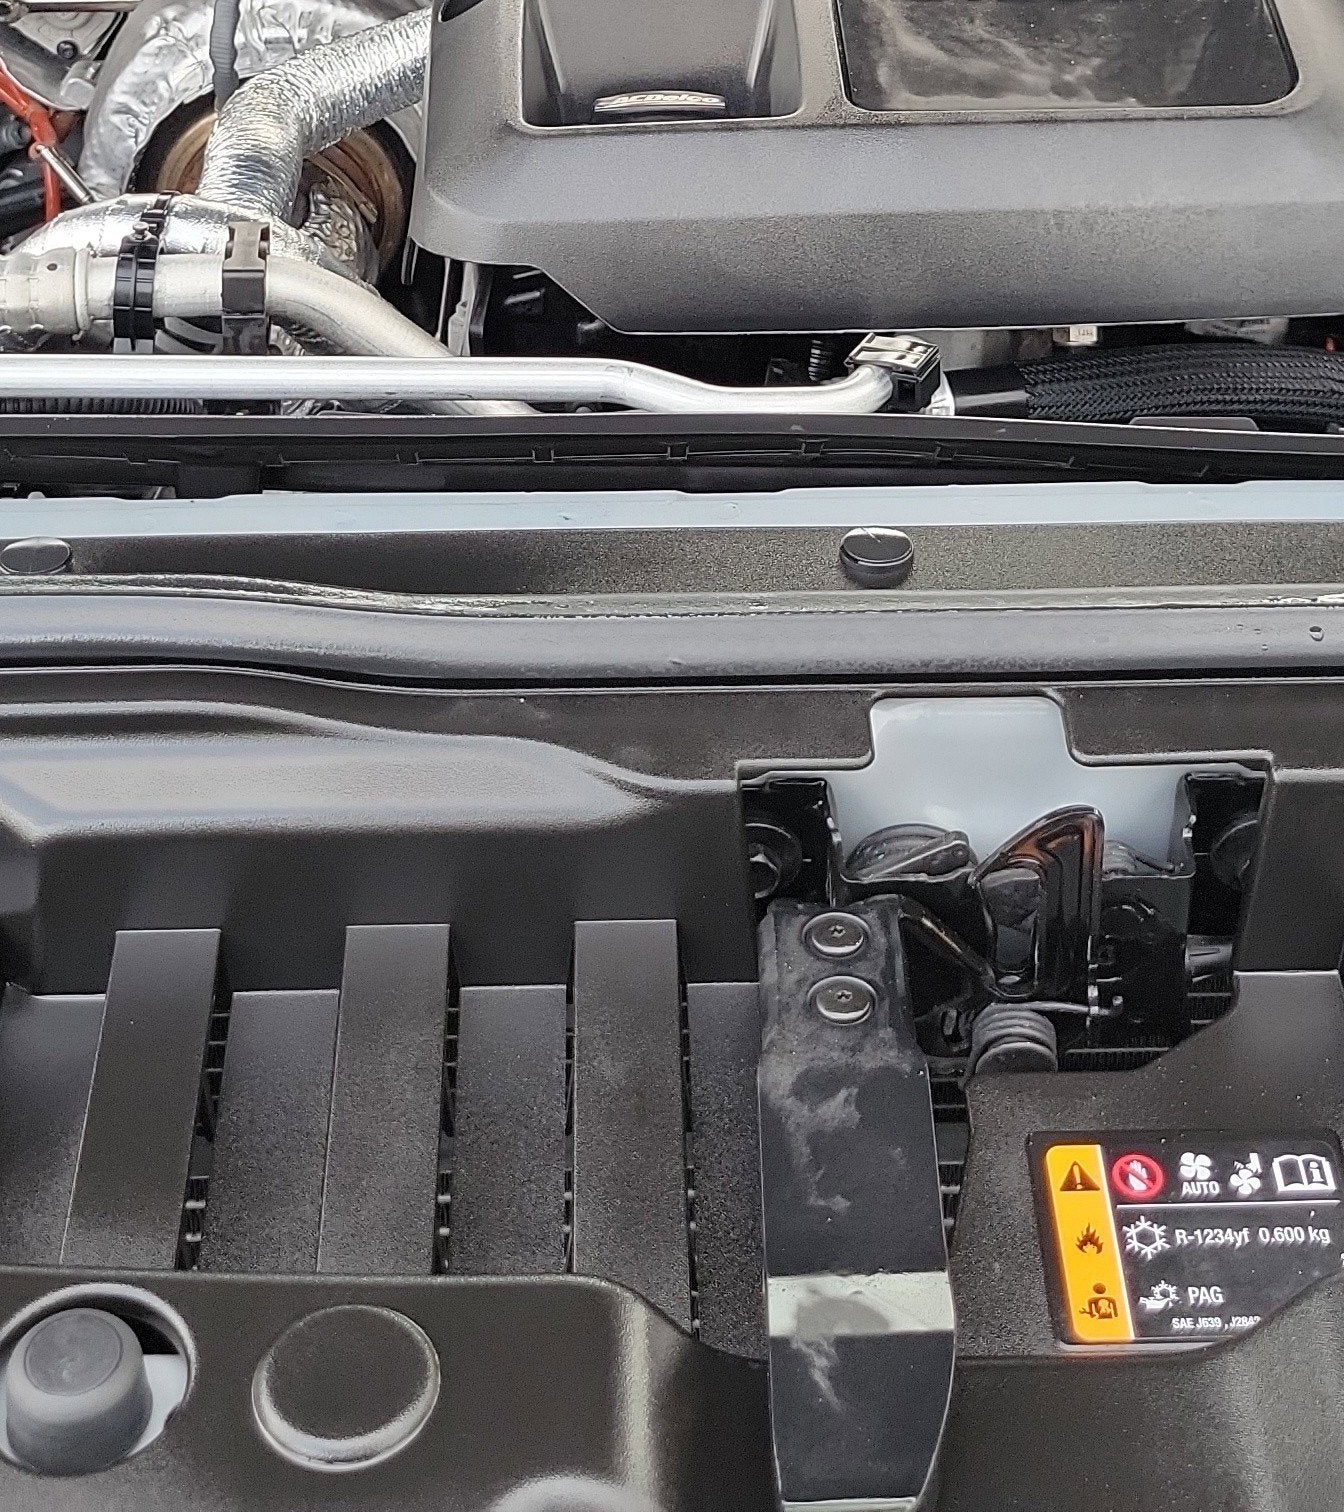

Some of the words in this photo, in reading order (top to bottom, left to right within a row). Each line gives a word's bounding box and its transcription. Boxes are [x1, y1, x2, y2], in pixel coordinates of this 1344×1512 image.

[611, 93, 720, 104] ACDelco
[1181, 1181, 1220, 1196] AUTO
[1175, 1228, 1250, 1246] R-1234yf
[1259, 1227, 1305, 1243] 0.600
[1308, 1226, 1331, 1245] kg
[1188, 1286, 1223, 1303] PAG
[1171, 1317, 1194, 1328] SAE
